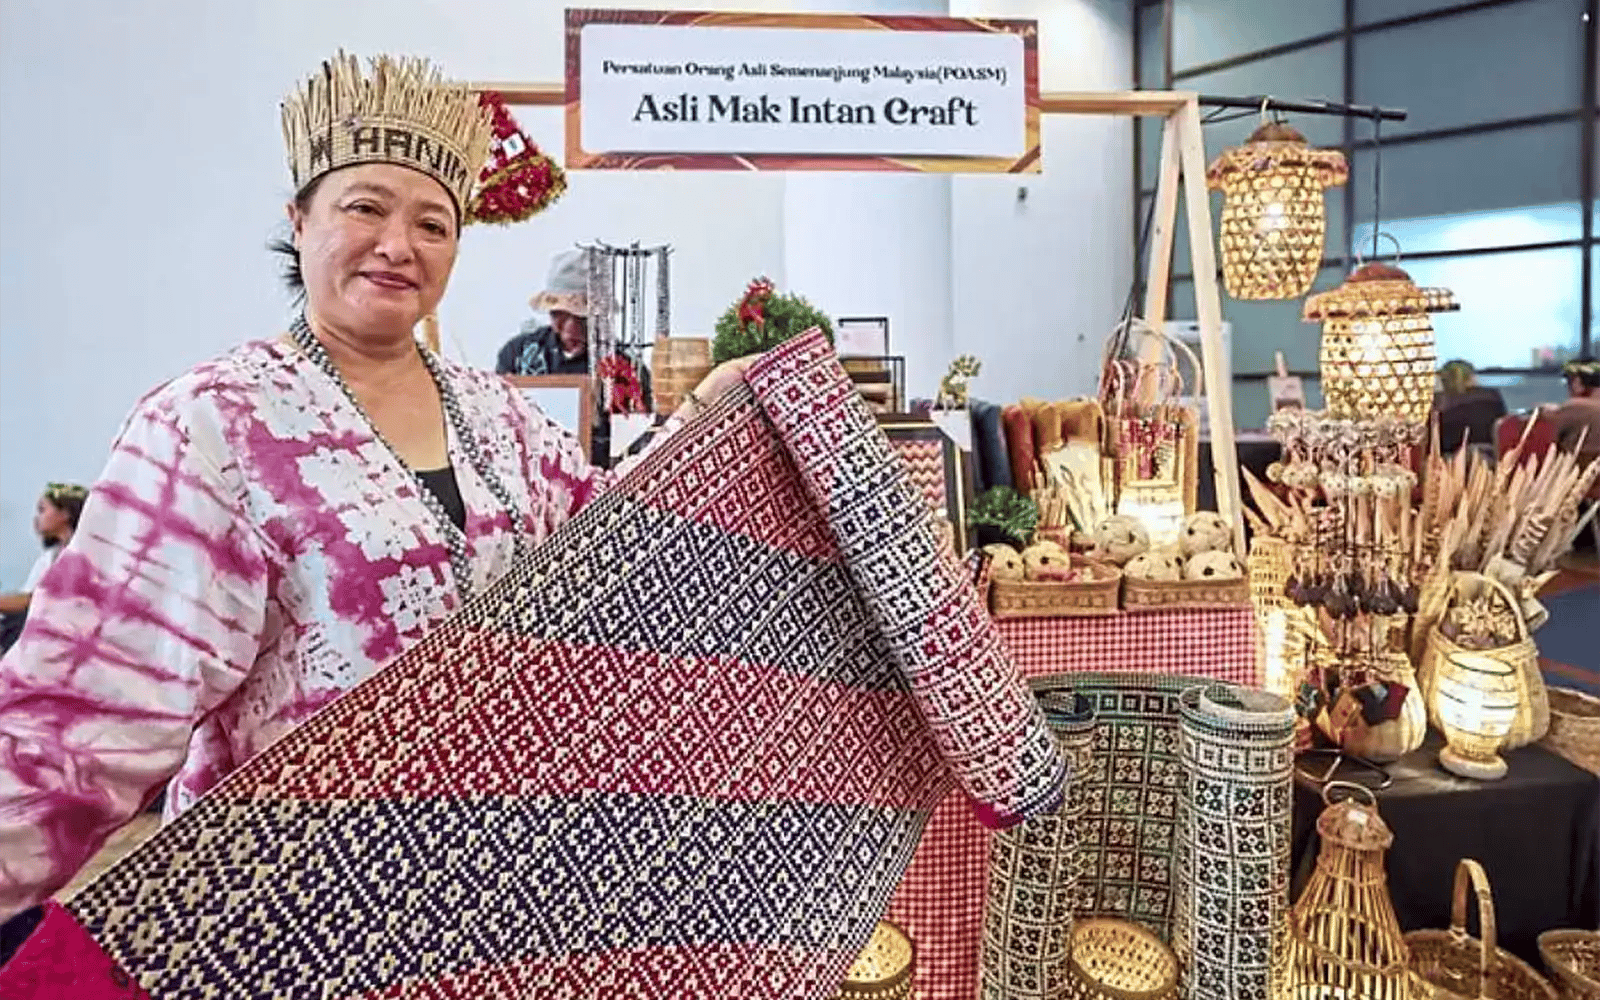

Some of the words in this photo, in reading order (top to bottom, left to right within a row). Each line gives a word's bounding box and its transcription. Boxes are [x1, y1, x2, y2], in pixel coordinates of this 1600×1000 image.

[602, 60, 682, 75] Persatuan
[685, 62, 735, 81] Orang
[738, 63, 768, 76] Asli
[769, 63, 870, 83] Semenanjung
[632, 92, 699, 122] Asli
[707, 94, 782, 123] Mak
[789, 95, 876, 124] Intan
[883, 96, 979, 126] Craft
